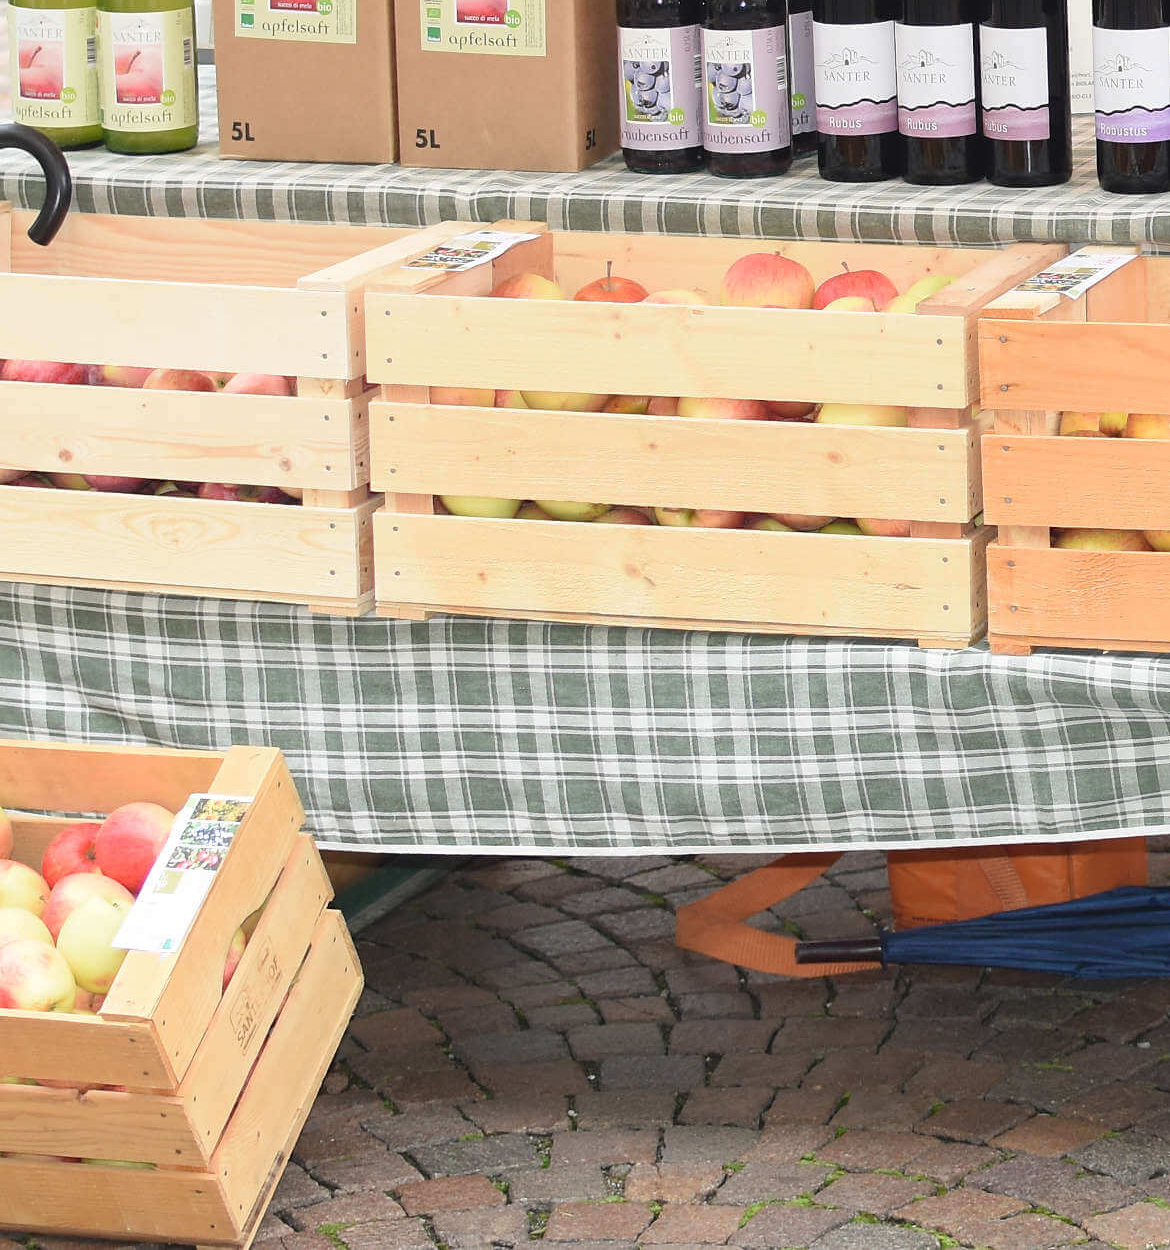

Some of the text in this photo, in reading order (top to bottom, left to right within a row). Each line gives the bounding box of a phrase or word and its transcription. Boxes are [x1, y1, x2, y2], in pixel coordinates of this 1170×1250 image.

[319, 2, 331, 10] bio
[507, 14, 520, 24] bio
[262, 19, 330, 36] apfelsaft
[449, 32, 518, 49] apfelsaft
[823, 71, 871, 82] SANTER
[902, 72, 947, 84] SANTER
[984, 75, 1016, 87] ANTER
[1099, 77, 1144, 89] SANTER
[61, 91, 75, 100] bio
[160, 93, 174, 103] bio
[111, 110, 172, 126] apfelsaft
[669, 111, 684, 121] bio
[752, 113, 766, 124] bio
[829, 117, 862, 128] Rubus
[907, 118, 938, 131] Rubus
[232, 122, 255, 141] 5L
[1100, 122, 1147, 137] Robustus
[416, 129, 440, 149] 5L
[586, 129, 596, 150] 5L
